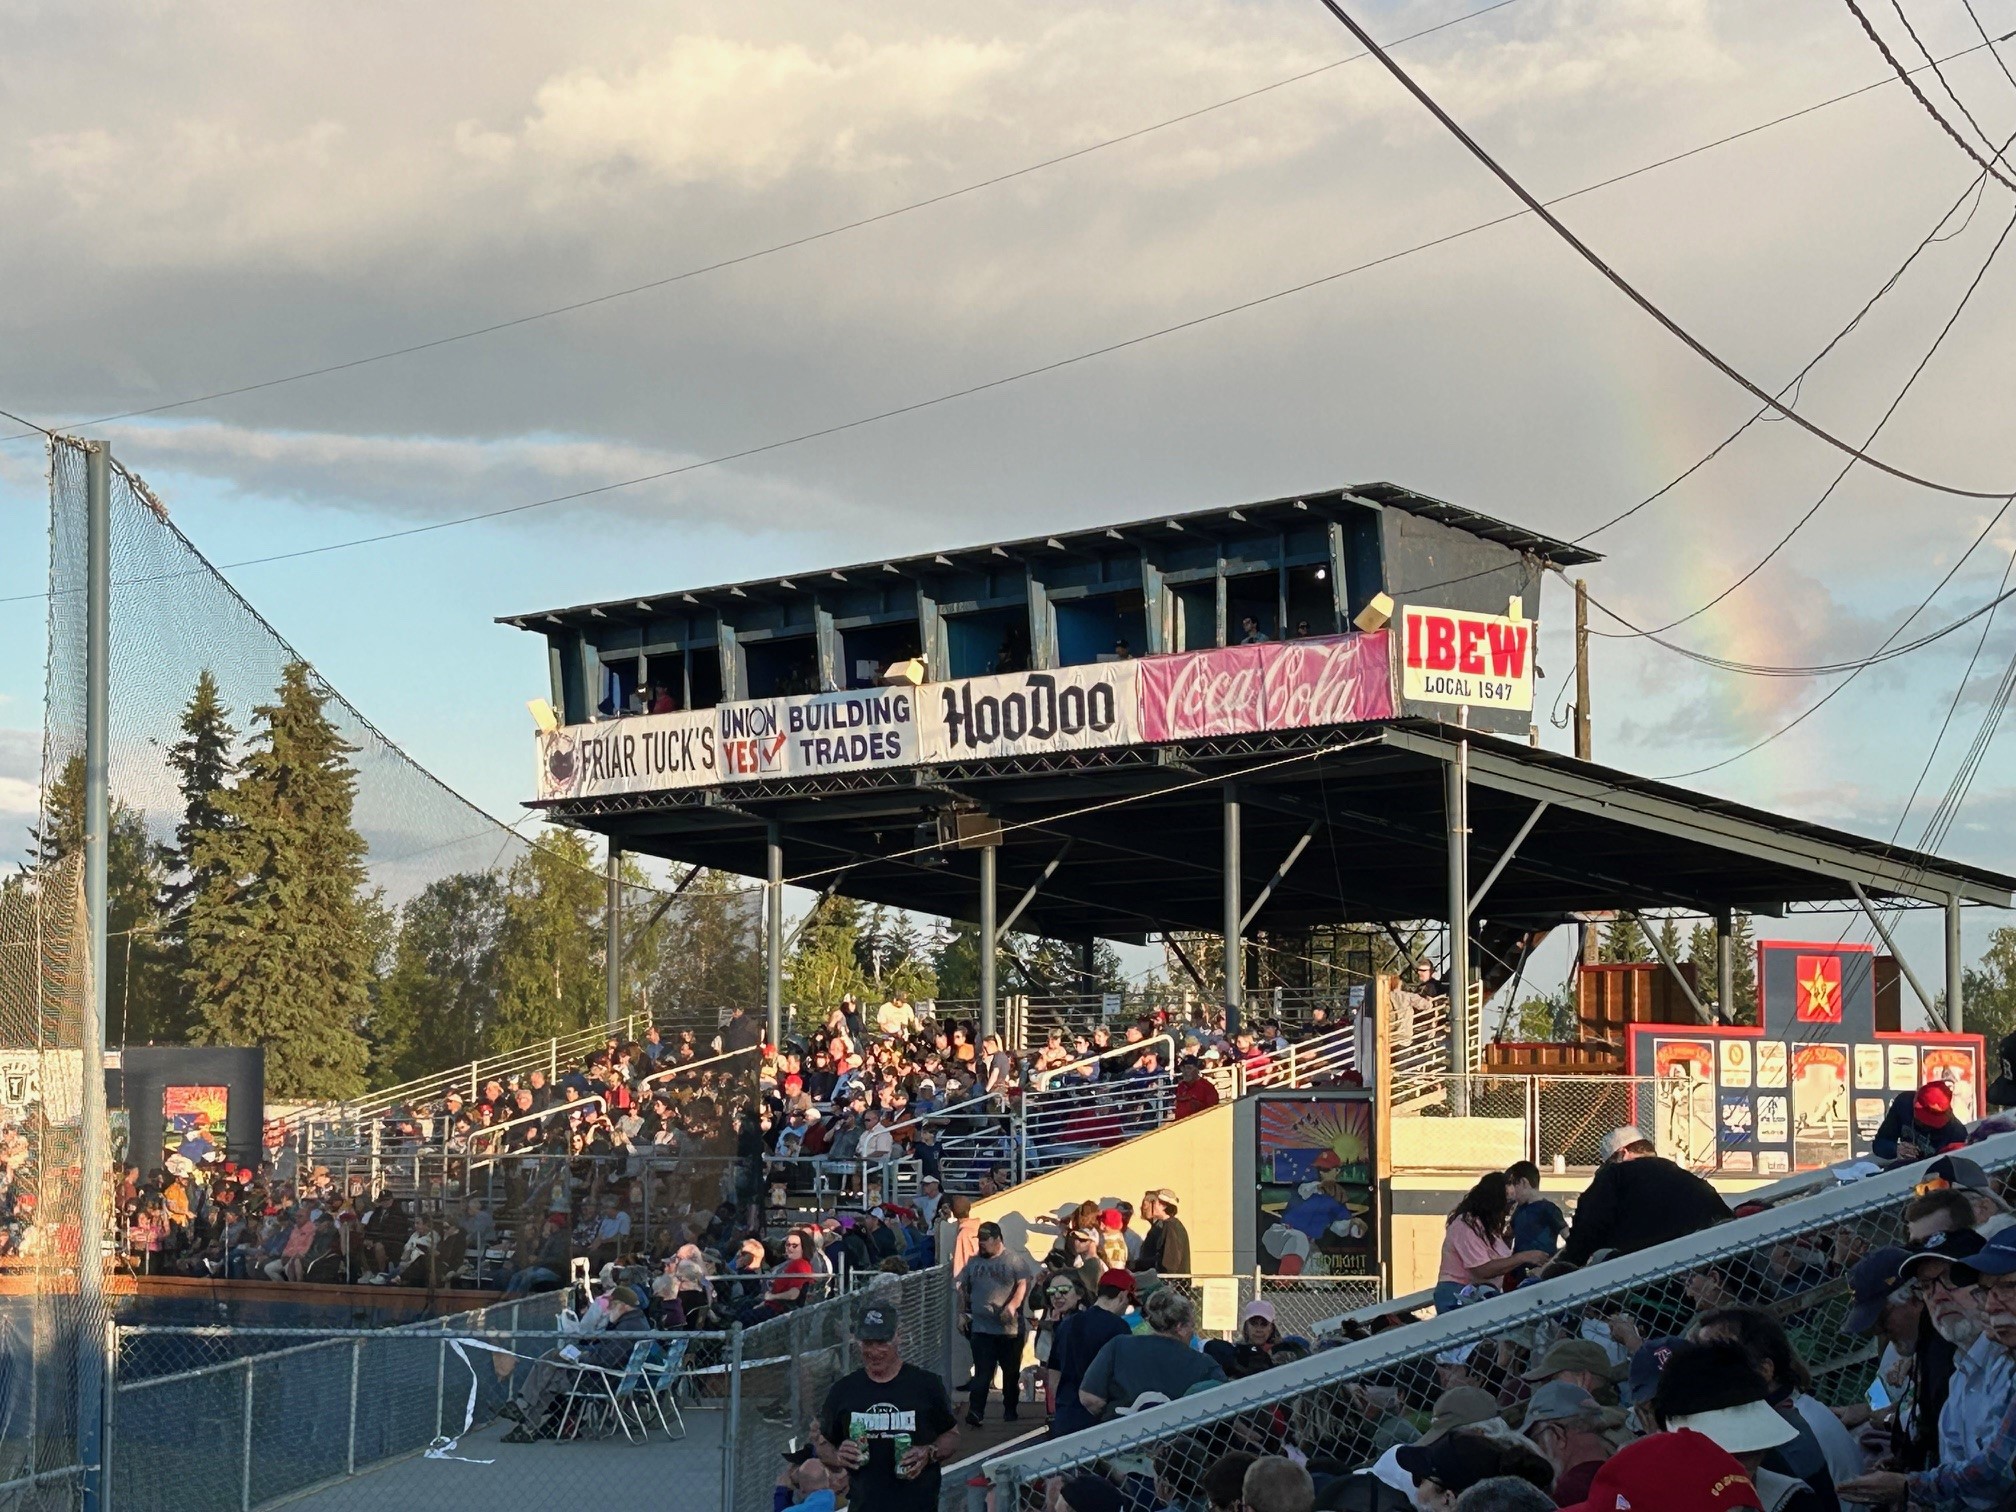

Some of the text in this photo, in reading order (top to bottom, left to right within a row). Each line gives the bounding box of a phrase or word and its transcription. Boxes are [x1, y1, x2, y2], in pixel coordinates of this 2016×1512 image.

[1406, 614, 1528, 679] IBEW
[1166, 640, 1361, 739] Coca Cola
[1424, 676, 1472, 697] LOCAL
[722, 704, 777, 739] UNION
[788, 694, 910, 733] BUILDING
[942, 674, 1115, 748] HooDoo
[581, 726, 716, 782] FRIAR TUCK'S
[723, 740, 758, 774] YES
[799, 731, 902, 767] TRADES
